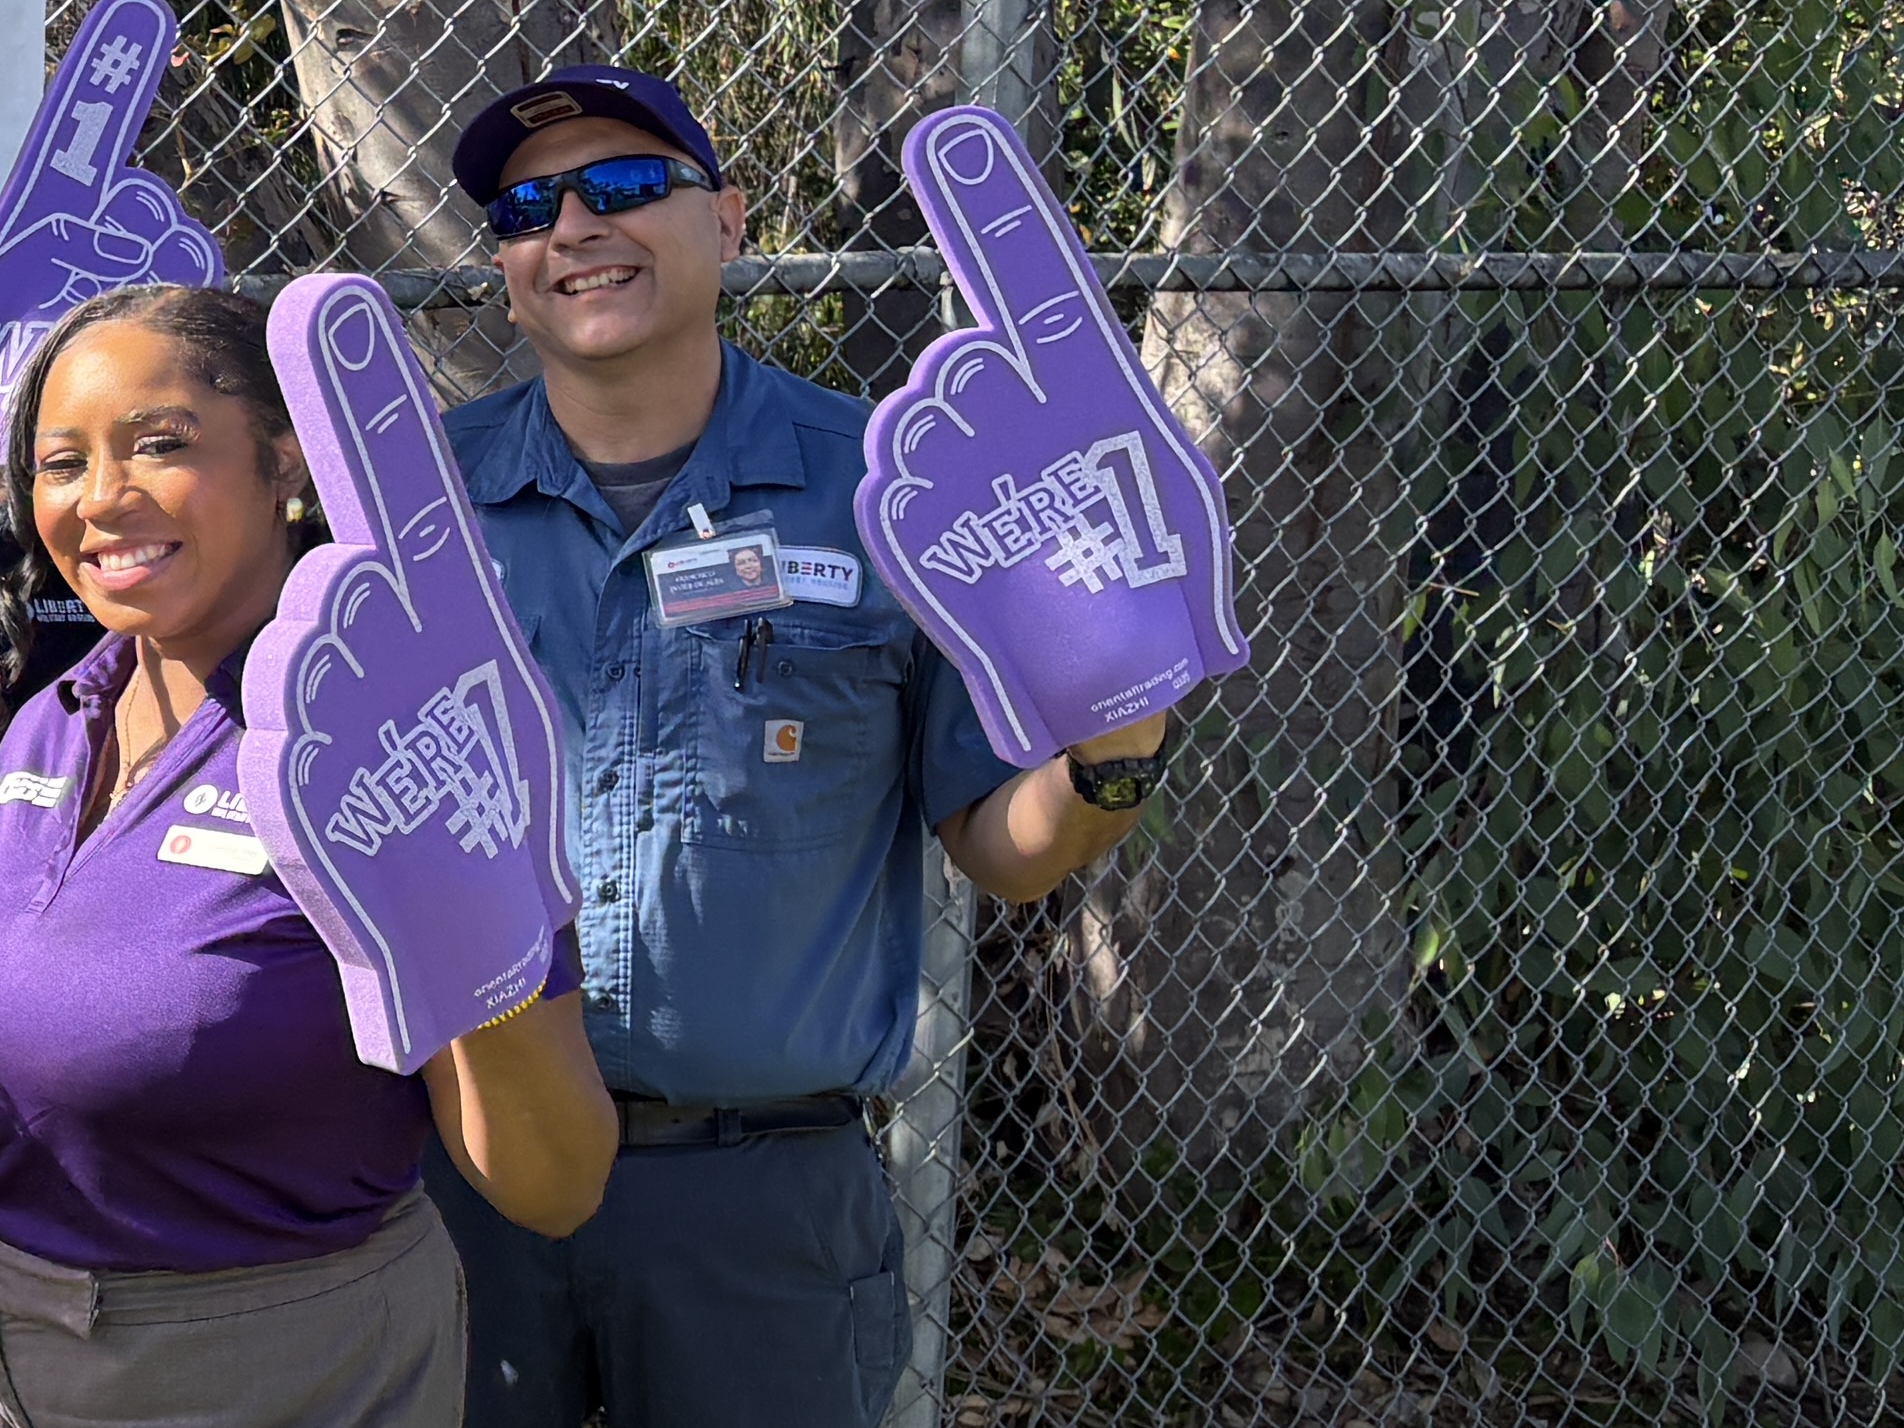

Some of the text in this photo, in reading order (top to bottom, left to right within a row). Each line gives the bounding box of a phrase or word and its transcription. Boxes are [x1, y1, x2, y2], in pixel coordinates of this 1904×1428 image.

[919, 451, 1106, 585] WE'RE
[1044, 431, 1187, 594] #1
[33, 598, 84, 614] LIBERT
[781, 560, 854, 582] IBERTY
